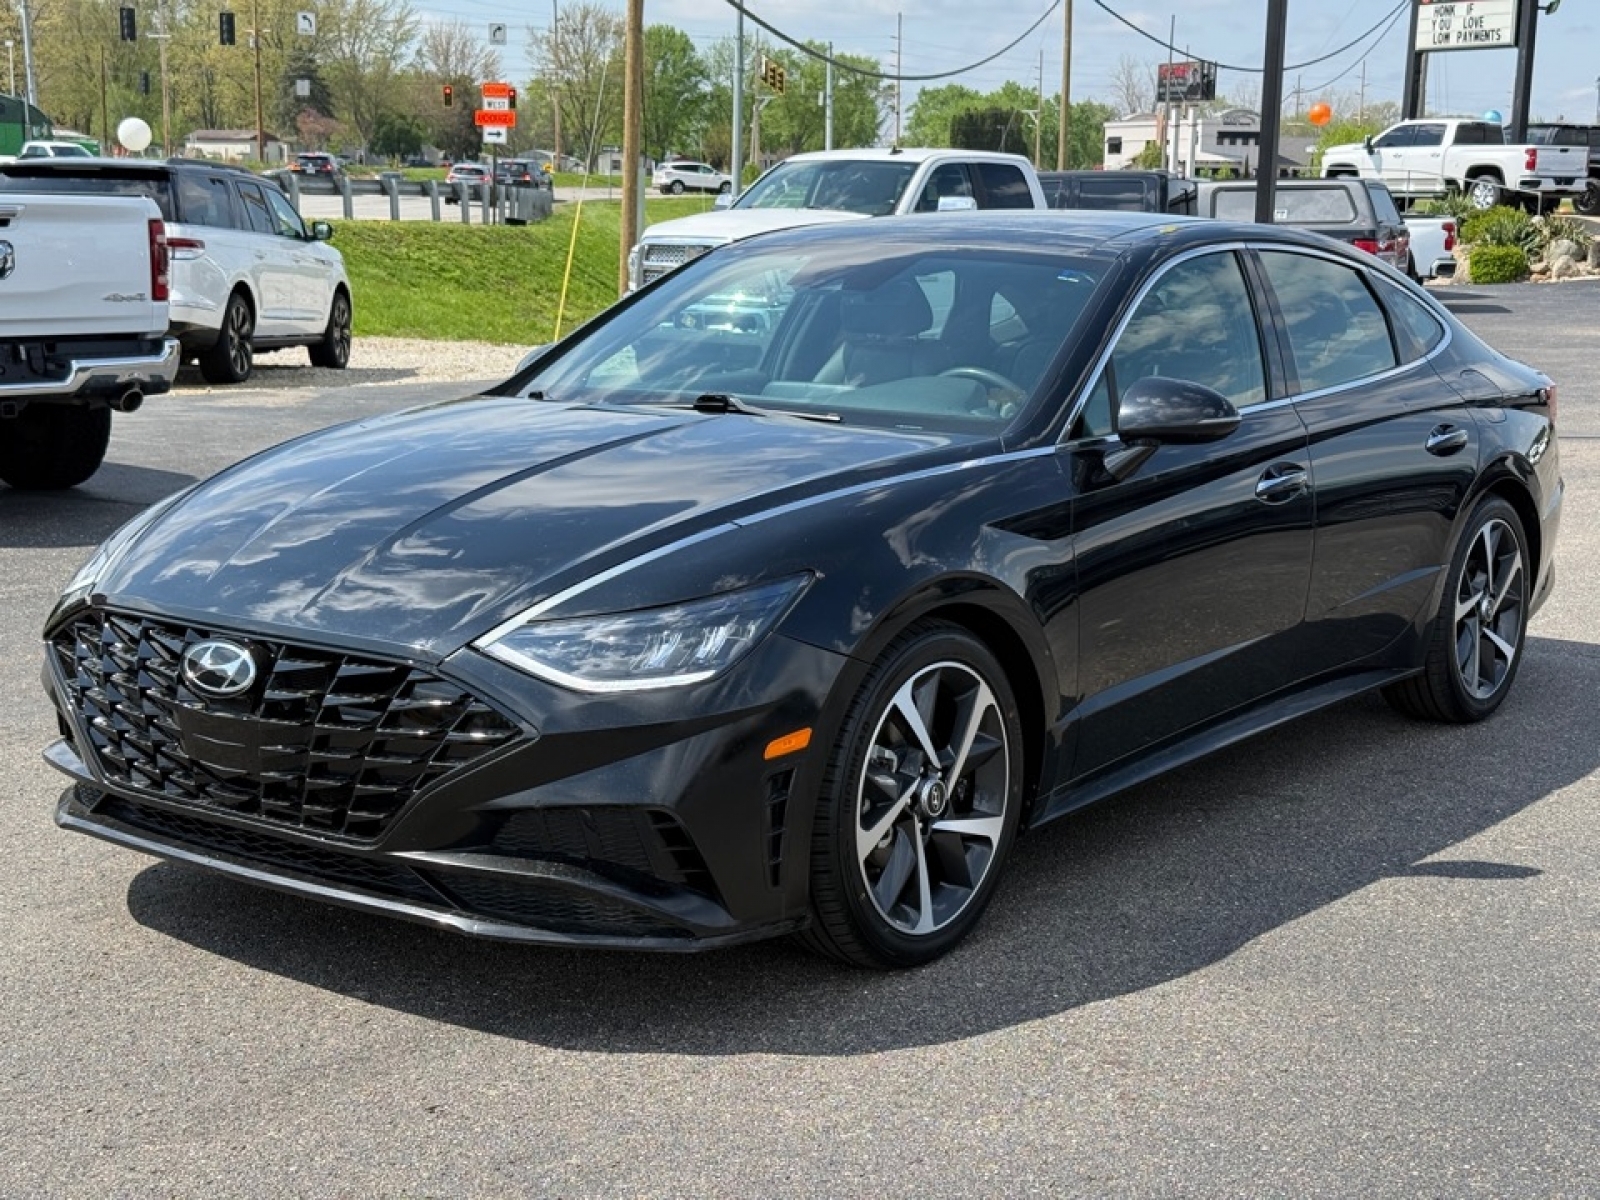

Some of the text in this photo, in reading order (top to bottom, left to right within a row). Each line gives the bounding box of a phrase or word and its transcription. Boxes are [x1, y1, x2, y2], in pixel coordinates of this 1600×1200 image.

[1434, 3, 1474, 17] HONK IF
[1432, 16, 1484, 31] YOU LOVE
[1433, 29, 1501, 45] LOW PAYMENTS
